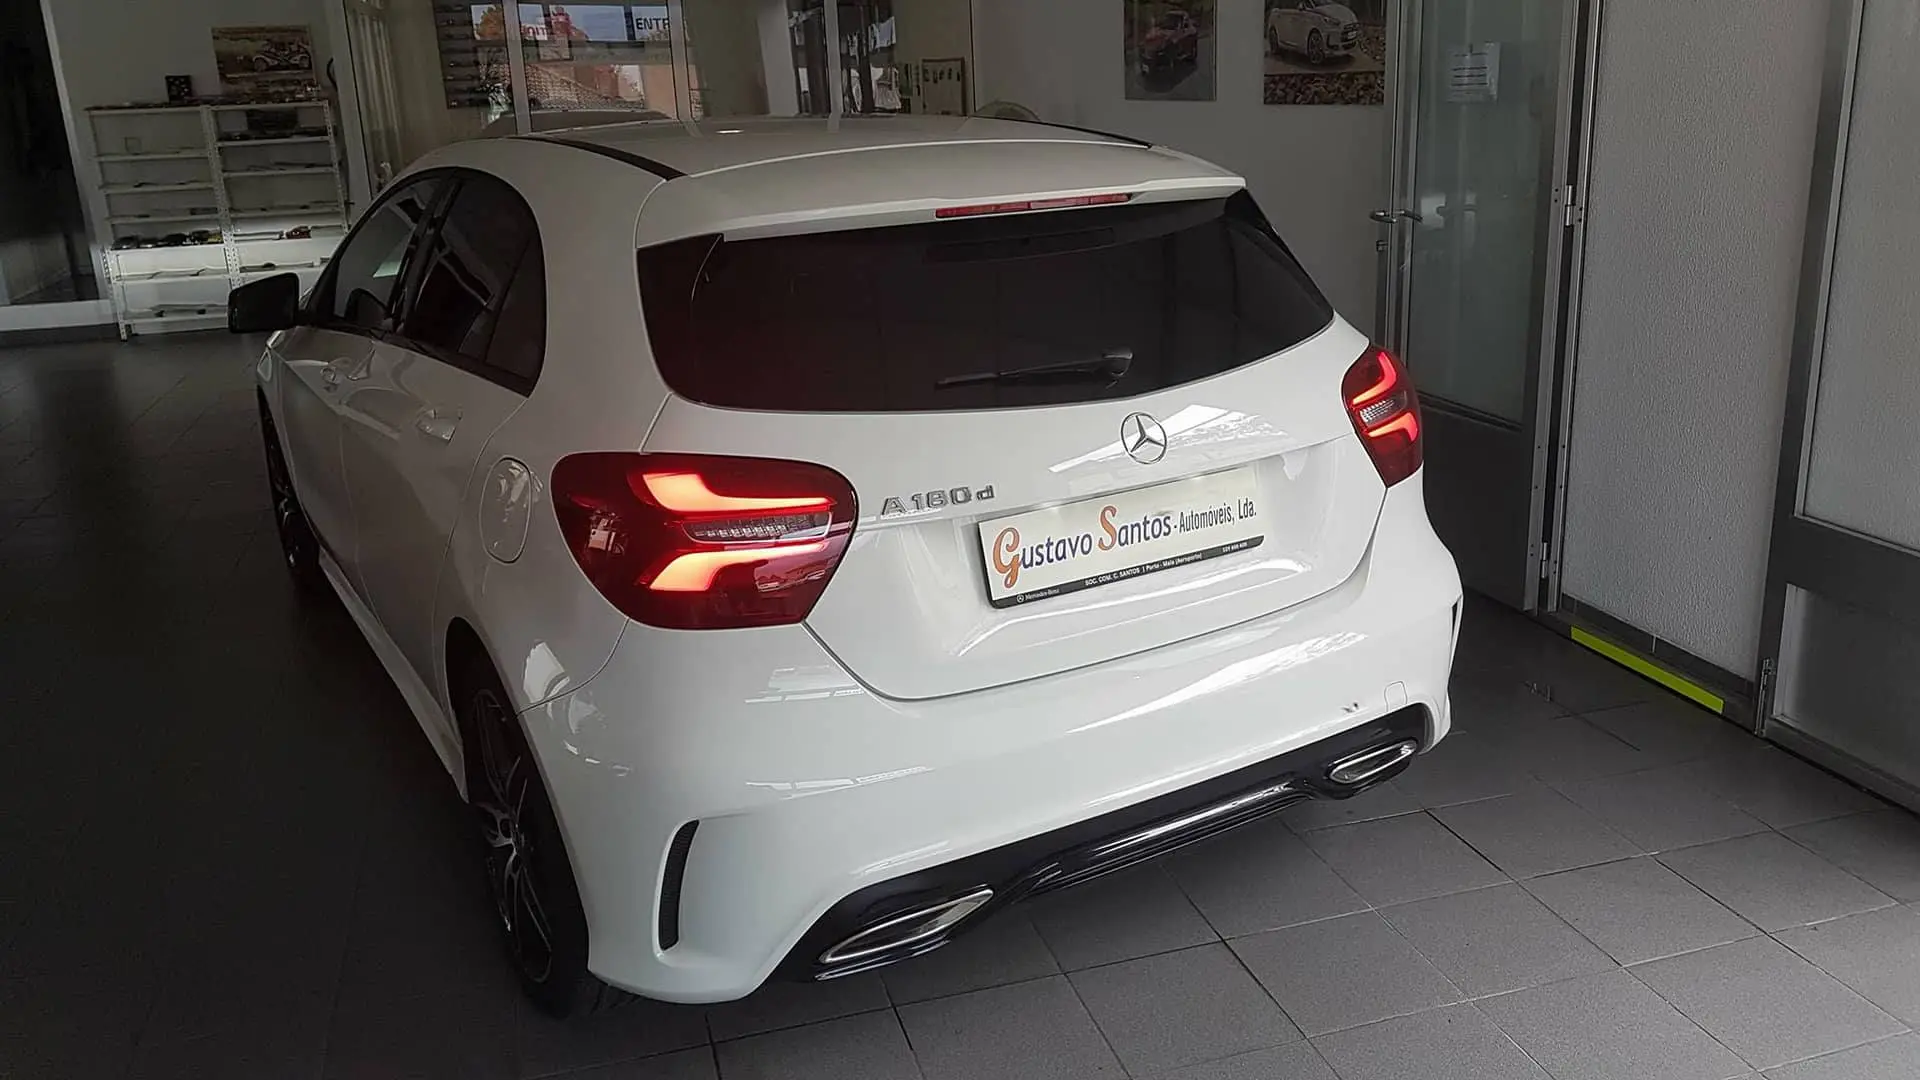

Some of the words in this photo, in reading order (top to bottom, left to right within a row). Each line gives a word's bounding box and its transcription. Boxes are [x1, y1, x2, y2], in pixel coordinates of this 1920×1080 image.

[993, 527, 1093, 588] Gustavo
[1098, 505, 1172, 551] Santos
[1179, 501, 1235, 534] Automóveis,
[1238, 497, 1257, 520] Lda.
[1119, 567, 1140, 577] SANTOS
